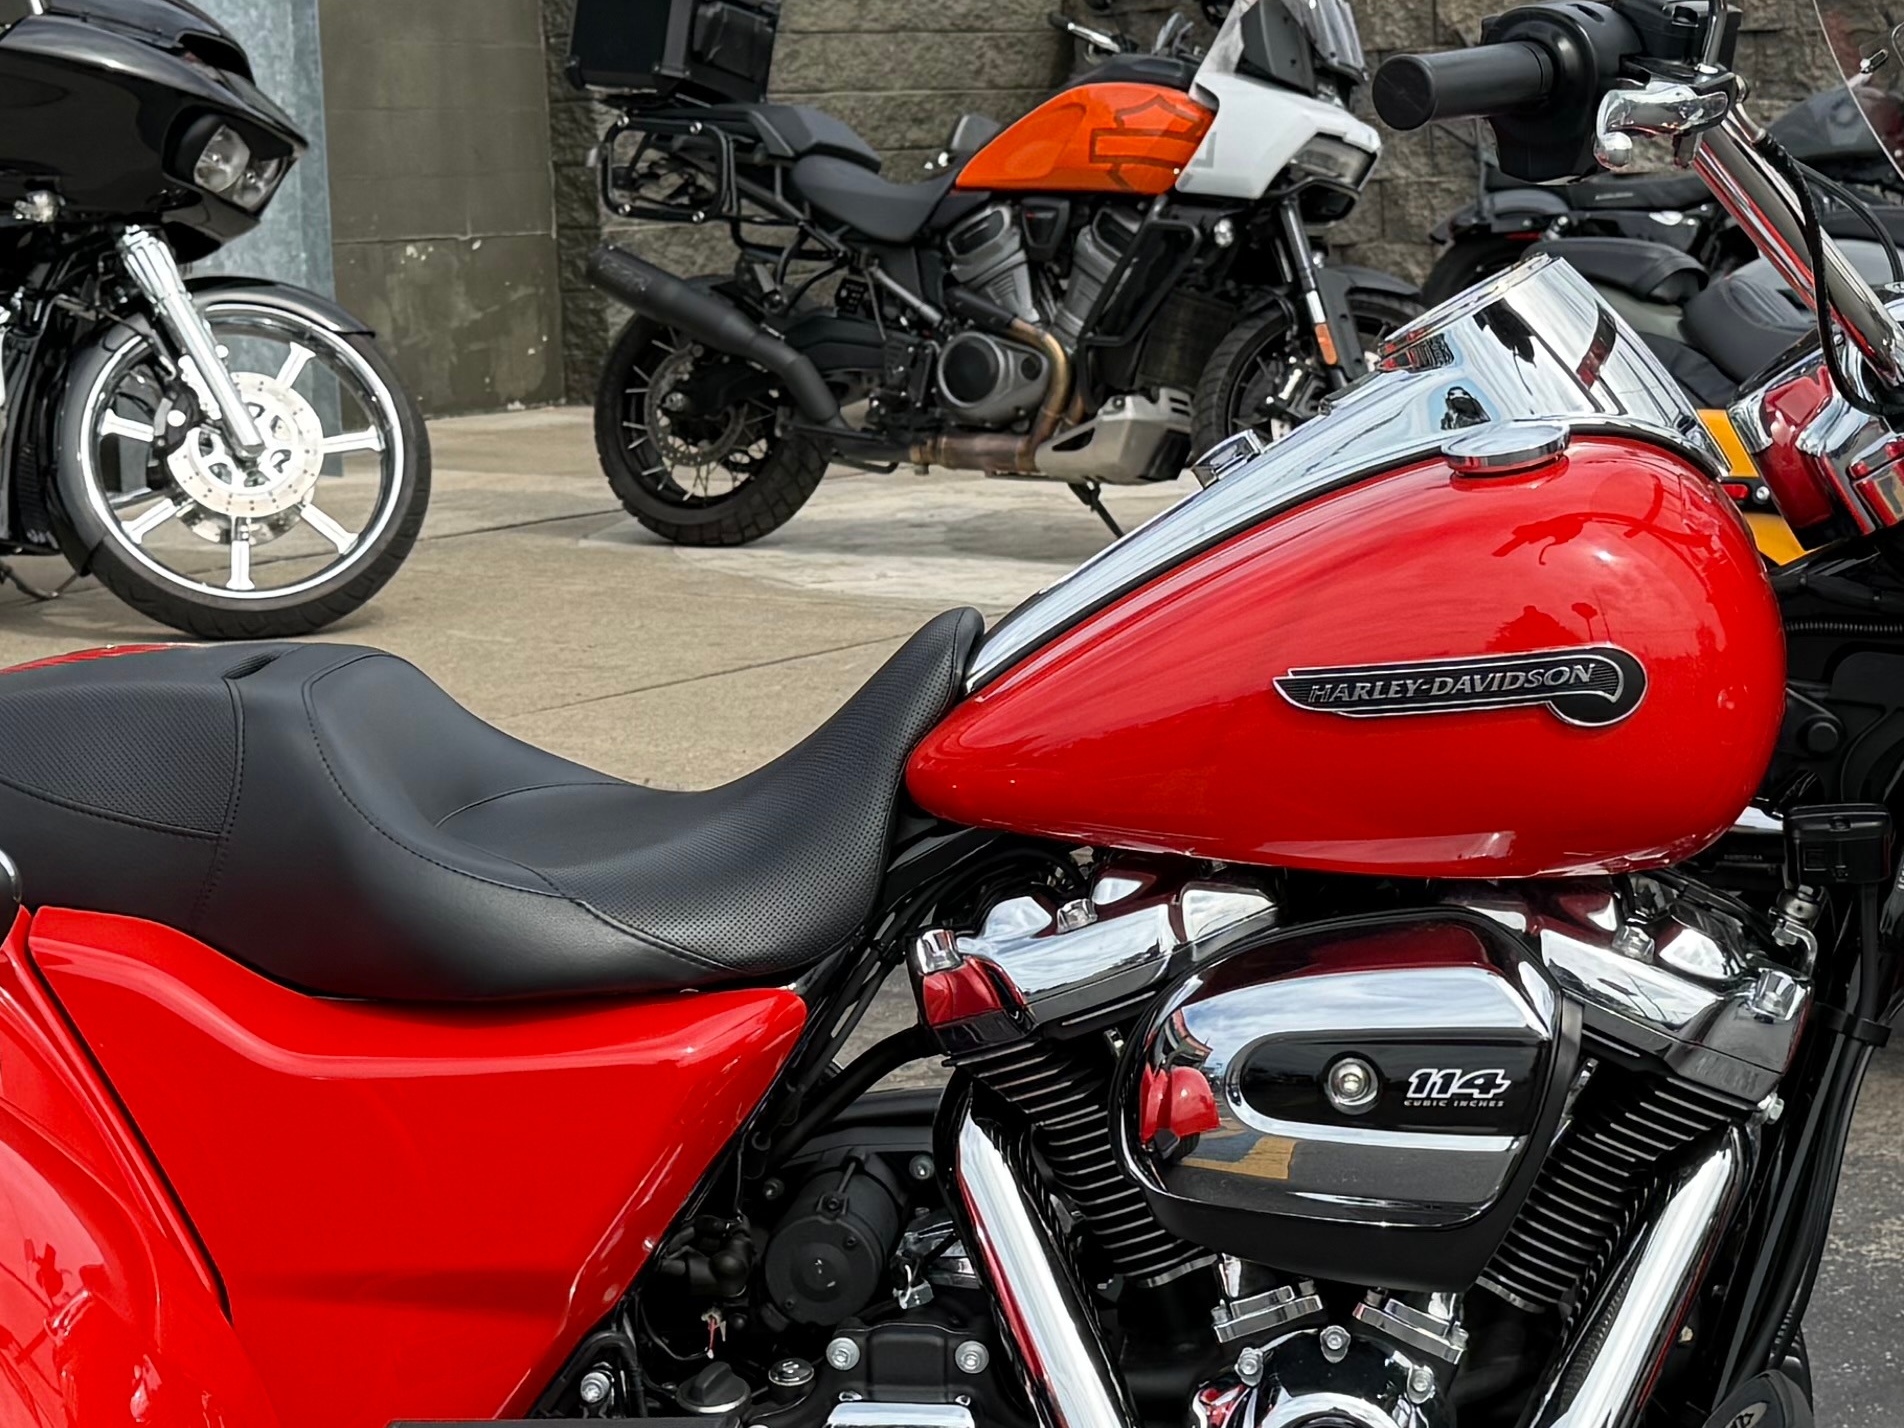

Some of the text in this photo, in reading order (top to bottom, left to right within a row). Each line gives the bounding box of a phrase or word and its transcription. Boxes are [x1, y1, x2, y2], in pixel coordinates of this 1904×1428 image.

[1307, 662, 1598, 704] HARLEY-DAVIDSON
[1406, 1068, 1512, 1099] 114
[1403, 1099, 1505, 1108] CUBIC INCHES
